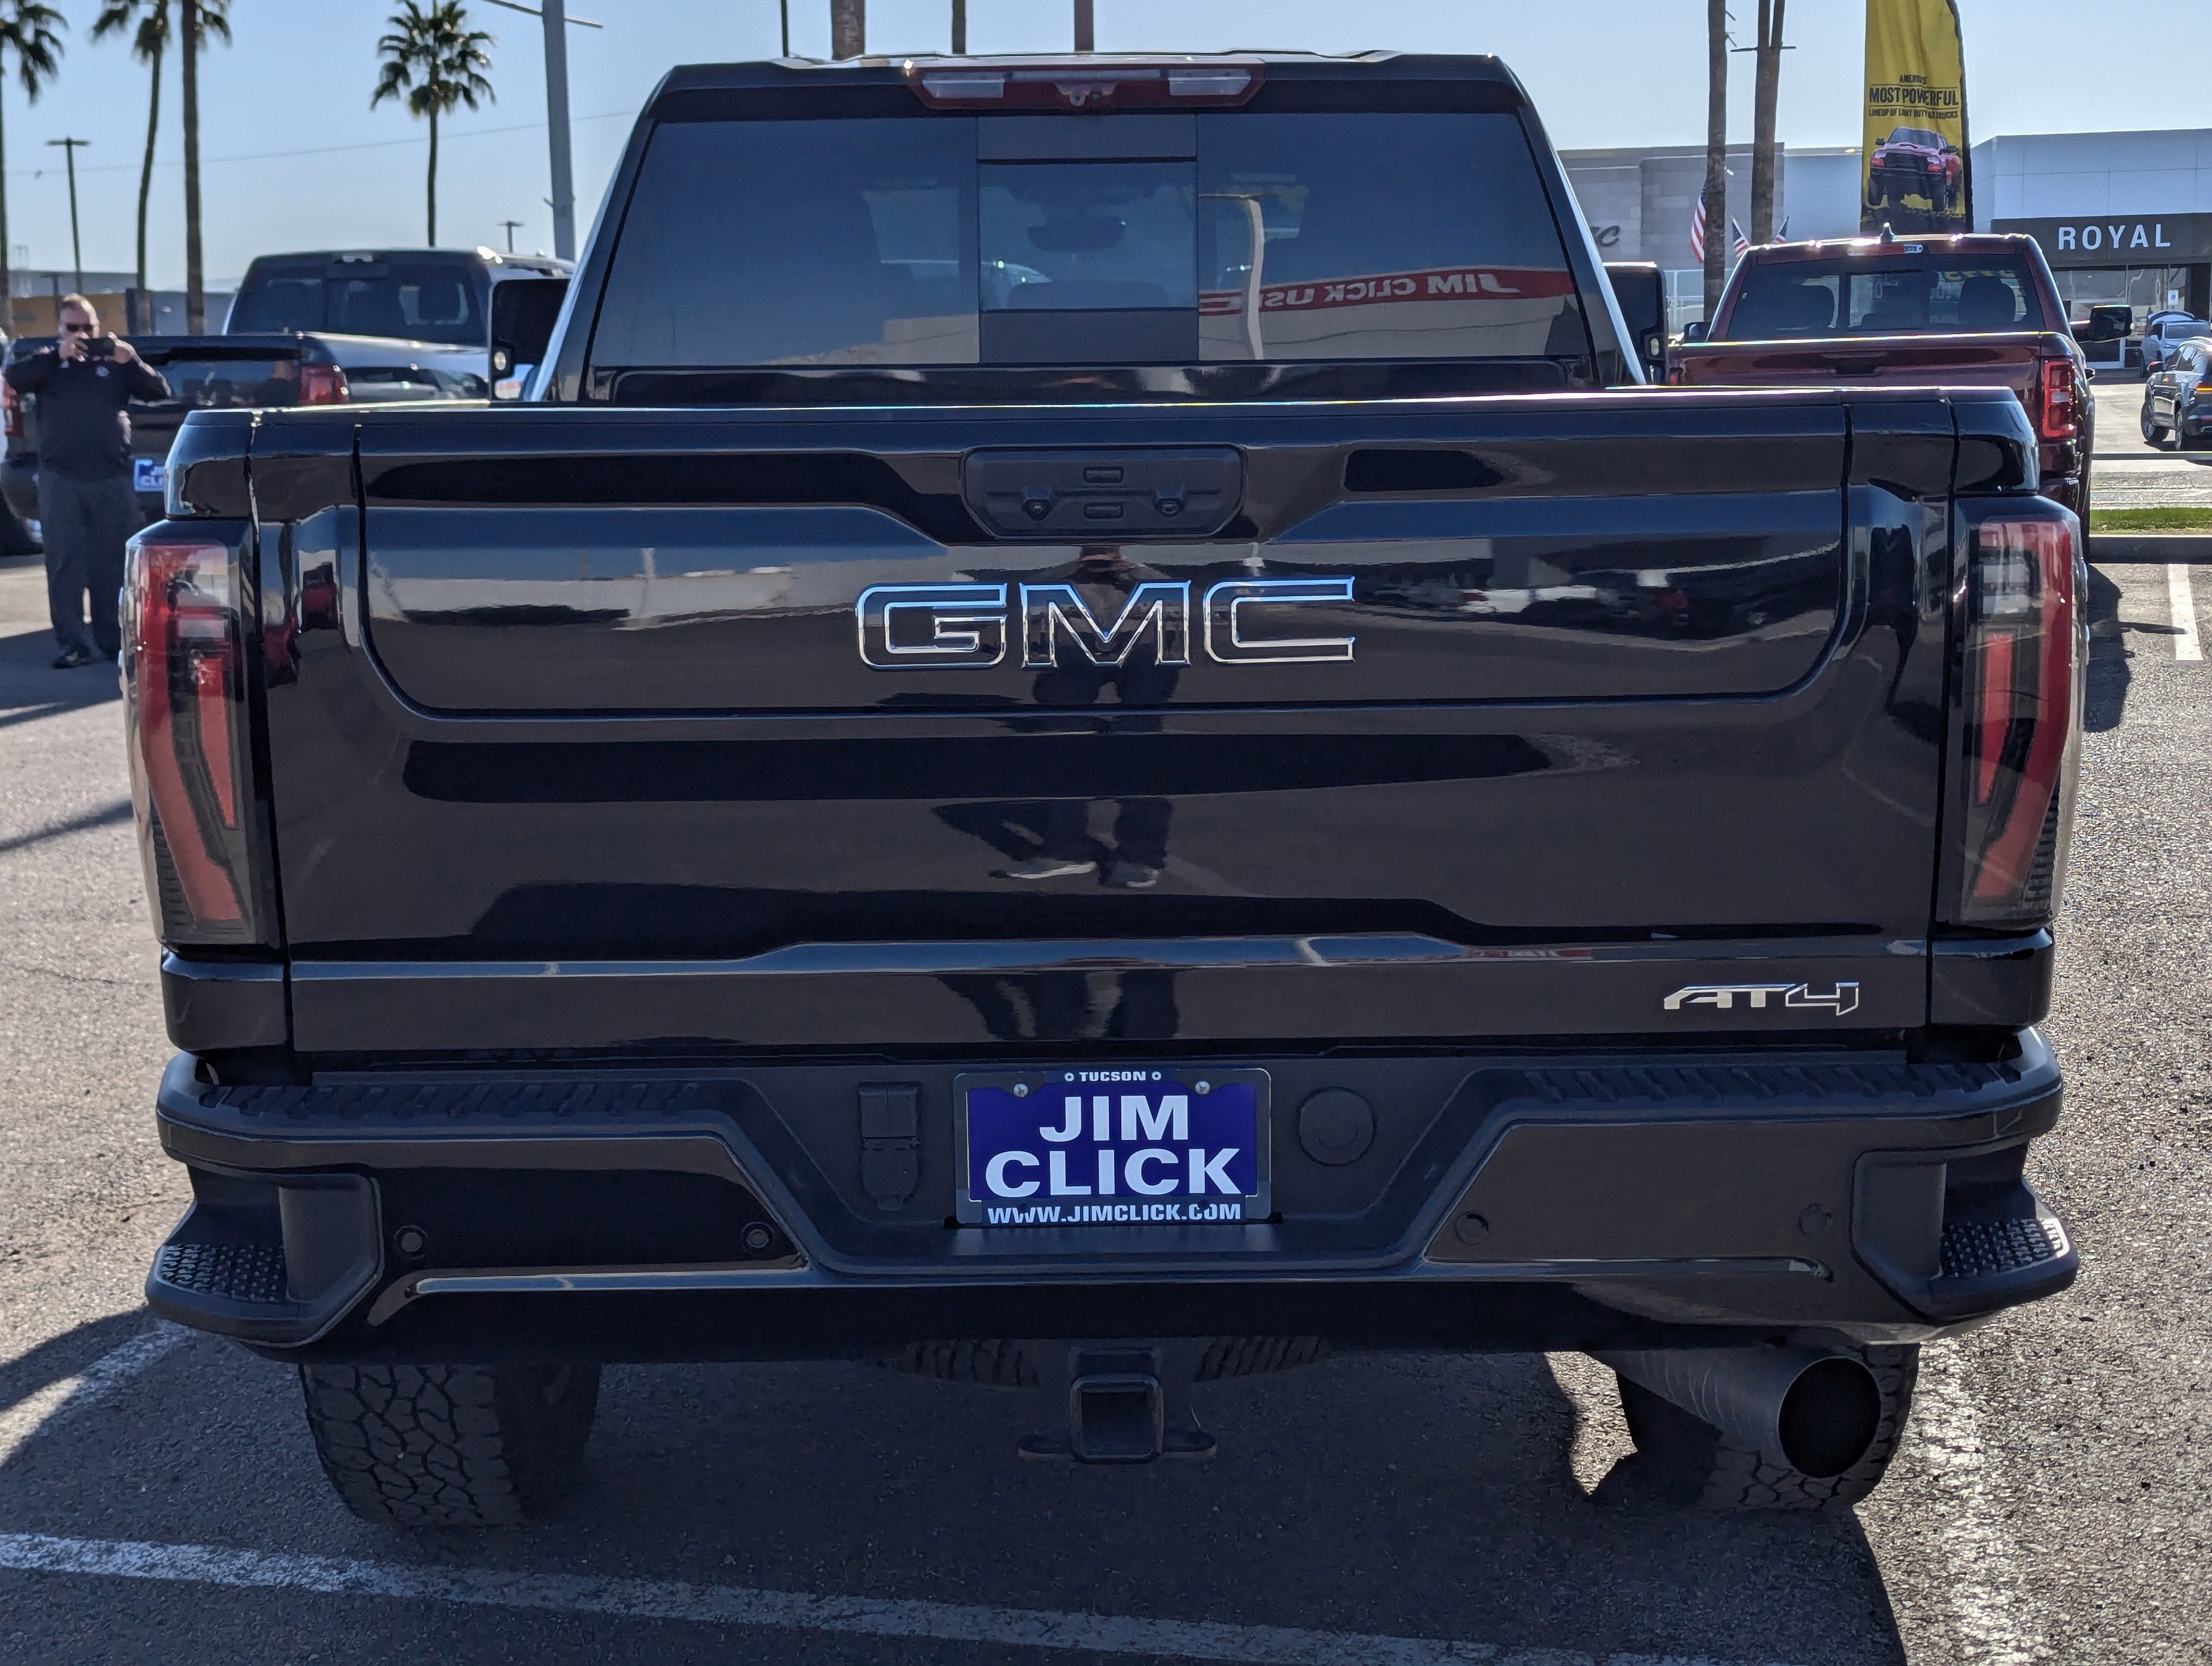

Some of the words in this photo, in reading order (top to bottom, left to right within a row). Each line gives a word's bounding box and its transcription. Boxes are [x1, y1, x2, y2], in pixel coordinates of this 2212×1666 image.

[1869, 87, 1900, 103] MOST
[1901, 88, 1959, 106] POWERFUL
[2058, 223, 2171, 251] ROYAL
[855, 576, 1355, 670] GMC
[1663, 982, 1860, 1016] AT4
[1079, 1071, 1146, 1082] TUCSON
[1039, 1094, 1188, 1143] JIM
[985, 1148, 1242, 1198] CLICK
[987, 1203, 1241, 1225] WWW.JIMCLICK.COM
